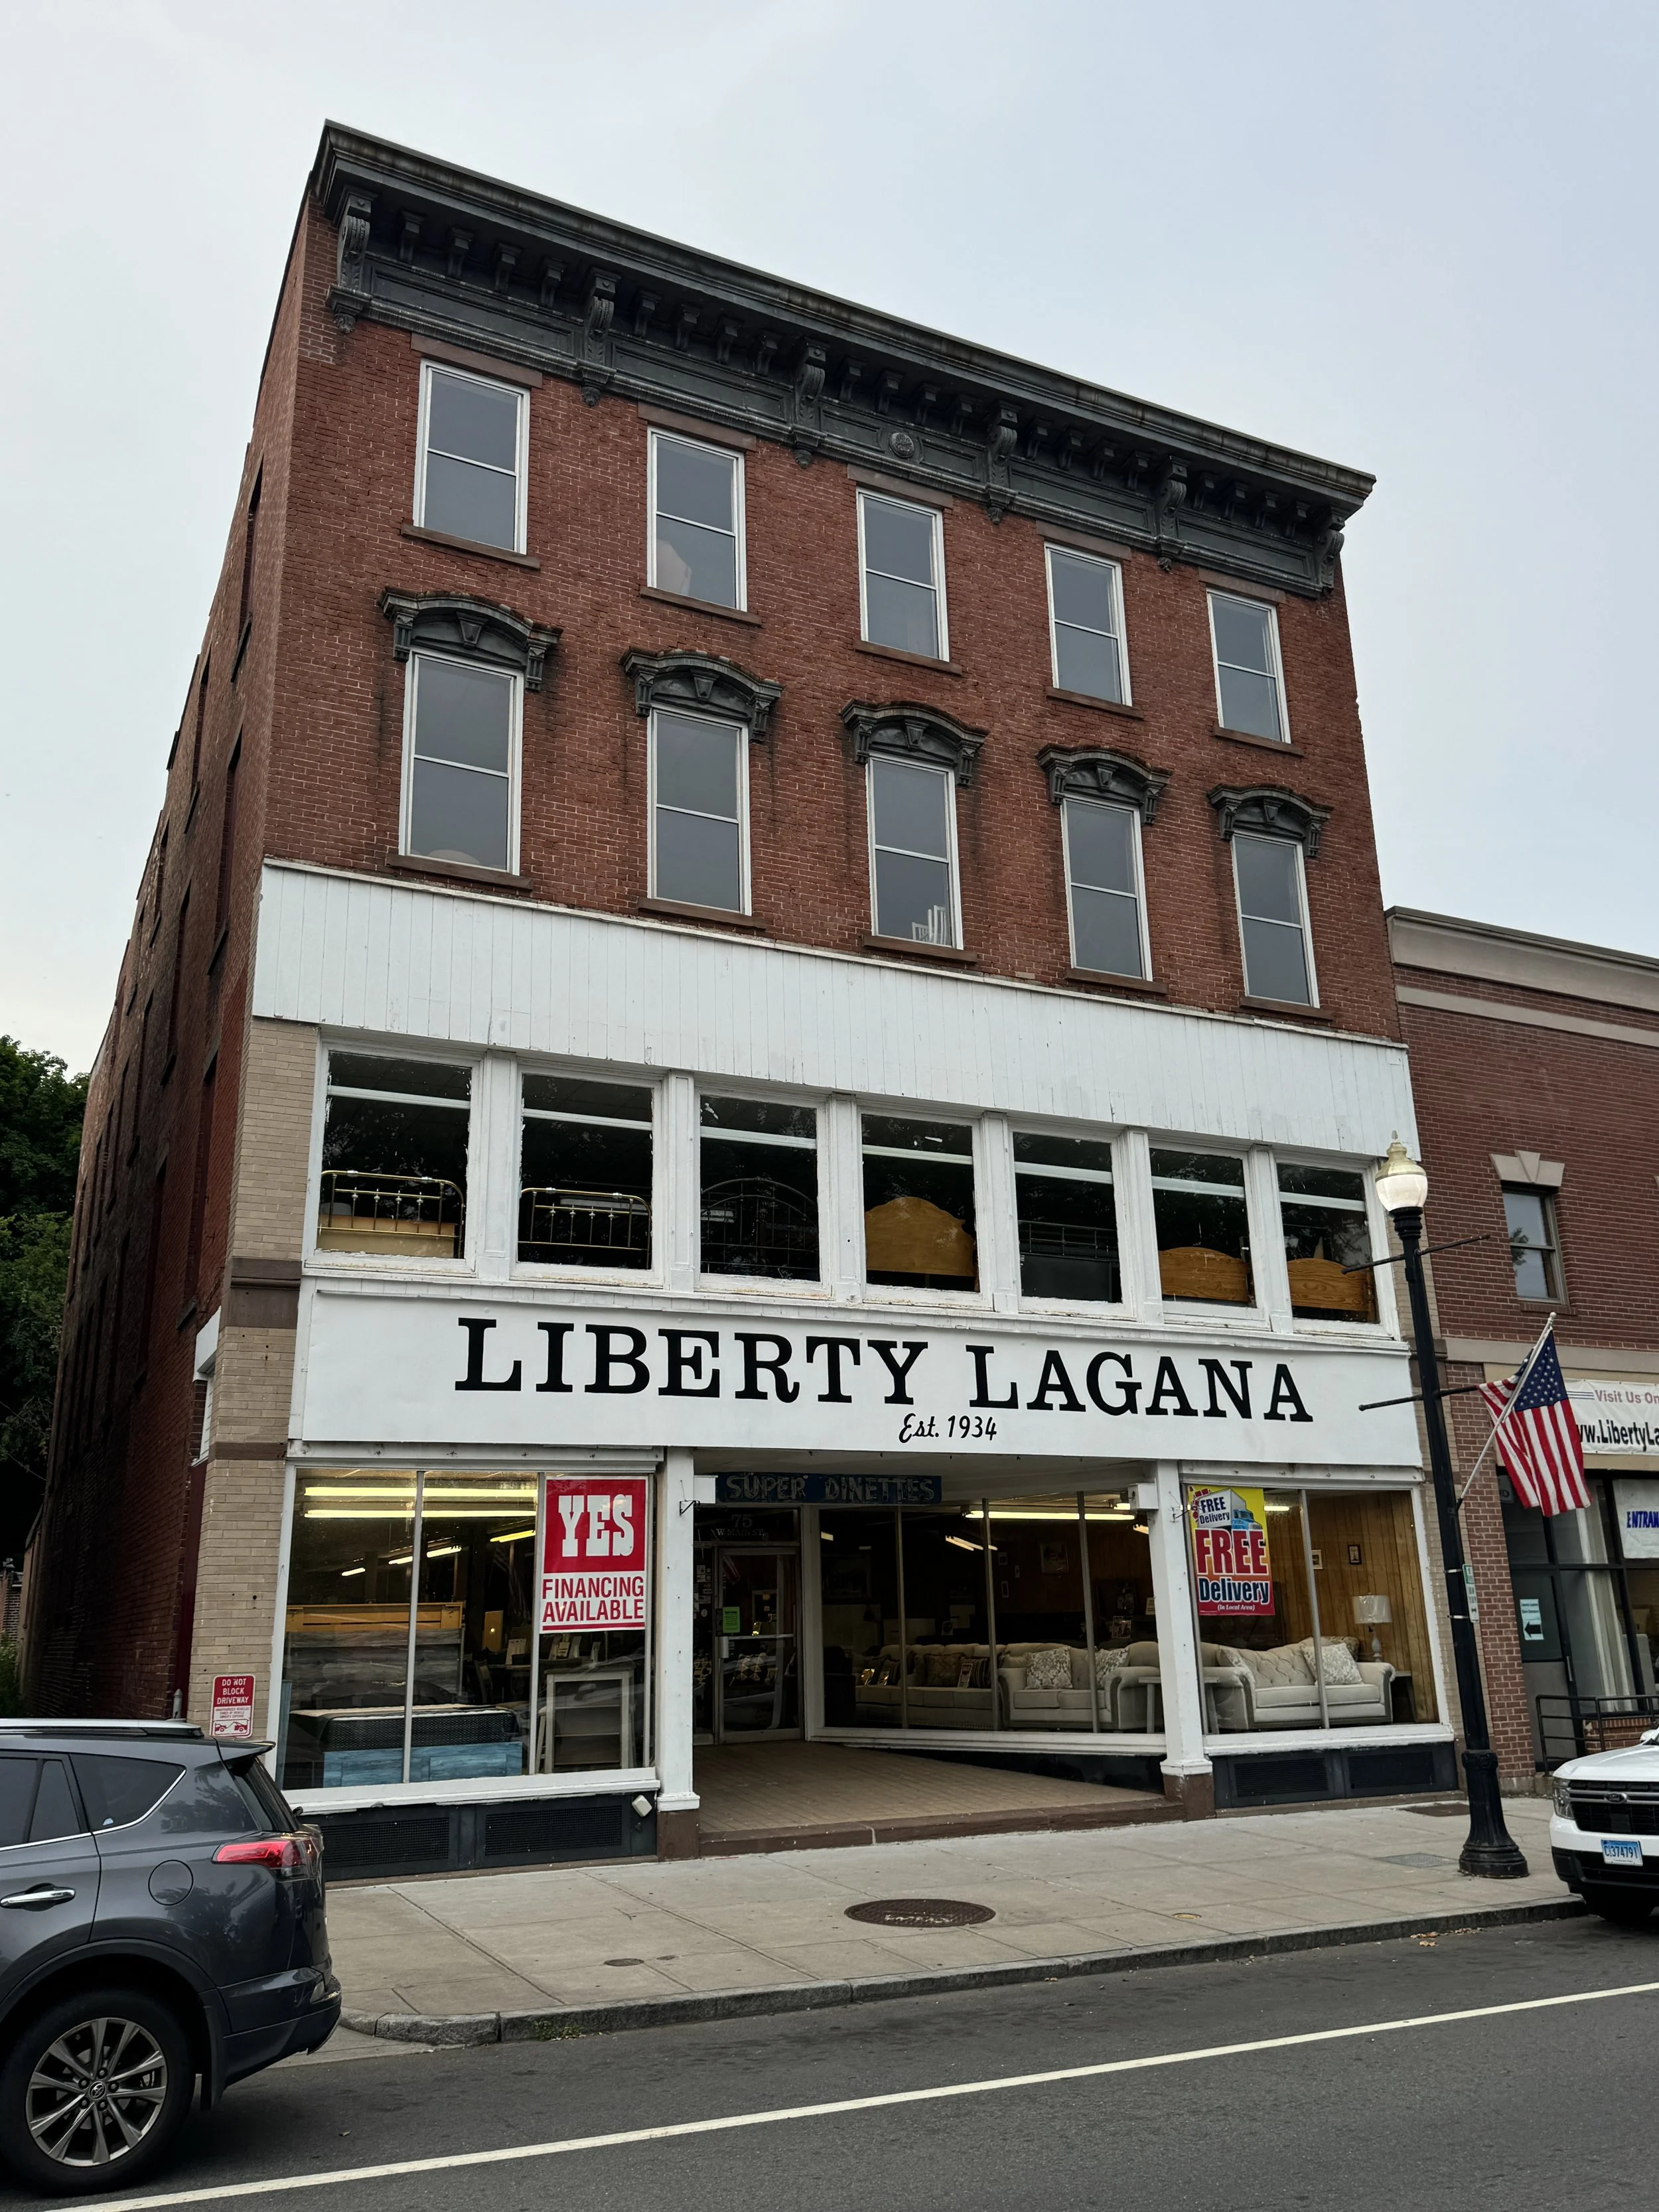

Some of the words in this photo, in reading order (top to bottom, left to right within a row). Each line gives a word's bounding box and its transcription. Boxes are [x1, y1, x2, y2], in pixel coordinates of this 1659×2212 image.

[455, 1317, 928, 1405] LIBERTY
[966, 1345, 1313, 1422] LAGANA
[1595, 1390, 1623, 1403] Visit
[1625, 1391, 1642, 1404] Us
[899, 1413, 940, 1443] Est.
[948, 1415, 997, 1441] 1934
[726, 1474, 806, 1501] SUPER
[824, 1475, 935, 1503] DINETTES
[1200, 1497, 1226, 1514] FREE
[558, 1494, 634, 1557] YES
[731, 1514, 753, 1528] 75
[1200, 1511, 1230, 1525] Delivery
[1195, 1529, 1268, 1574] FREE
[542, 1576, 644, 1599] FINANCING
[1198, 1577, 1269, 1603] Delivery
[542, 1599, 644, 1622] AVAILABLE
[216, 1696, 250, 1705] DRIVEWAY
